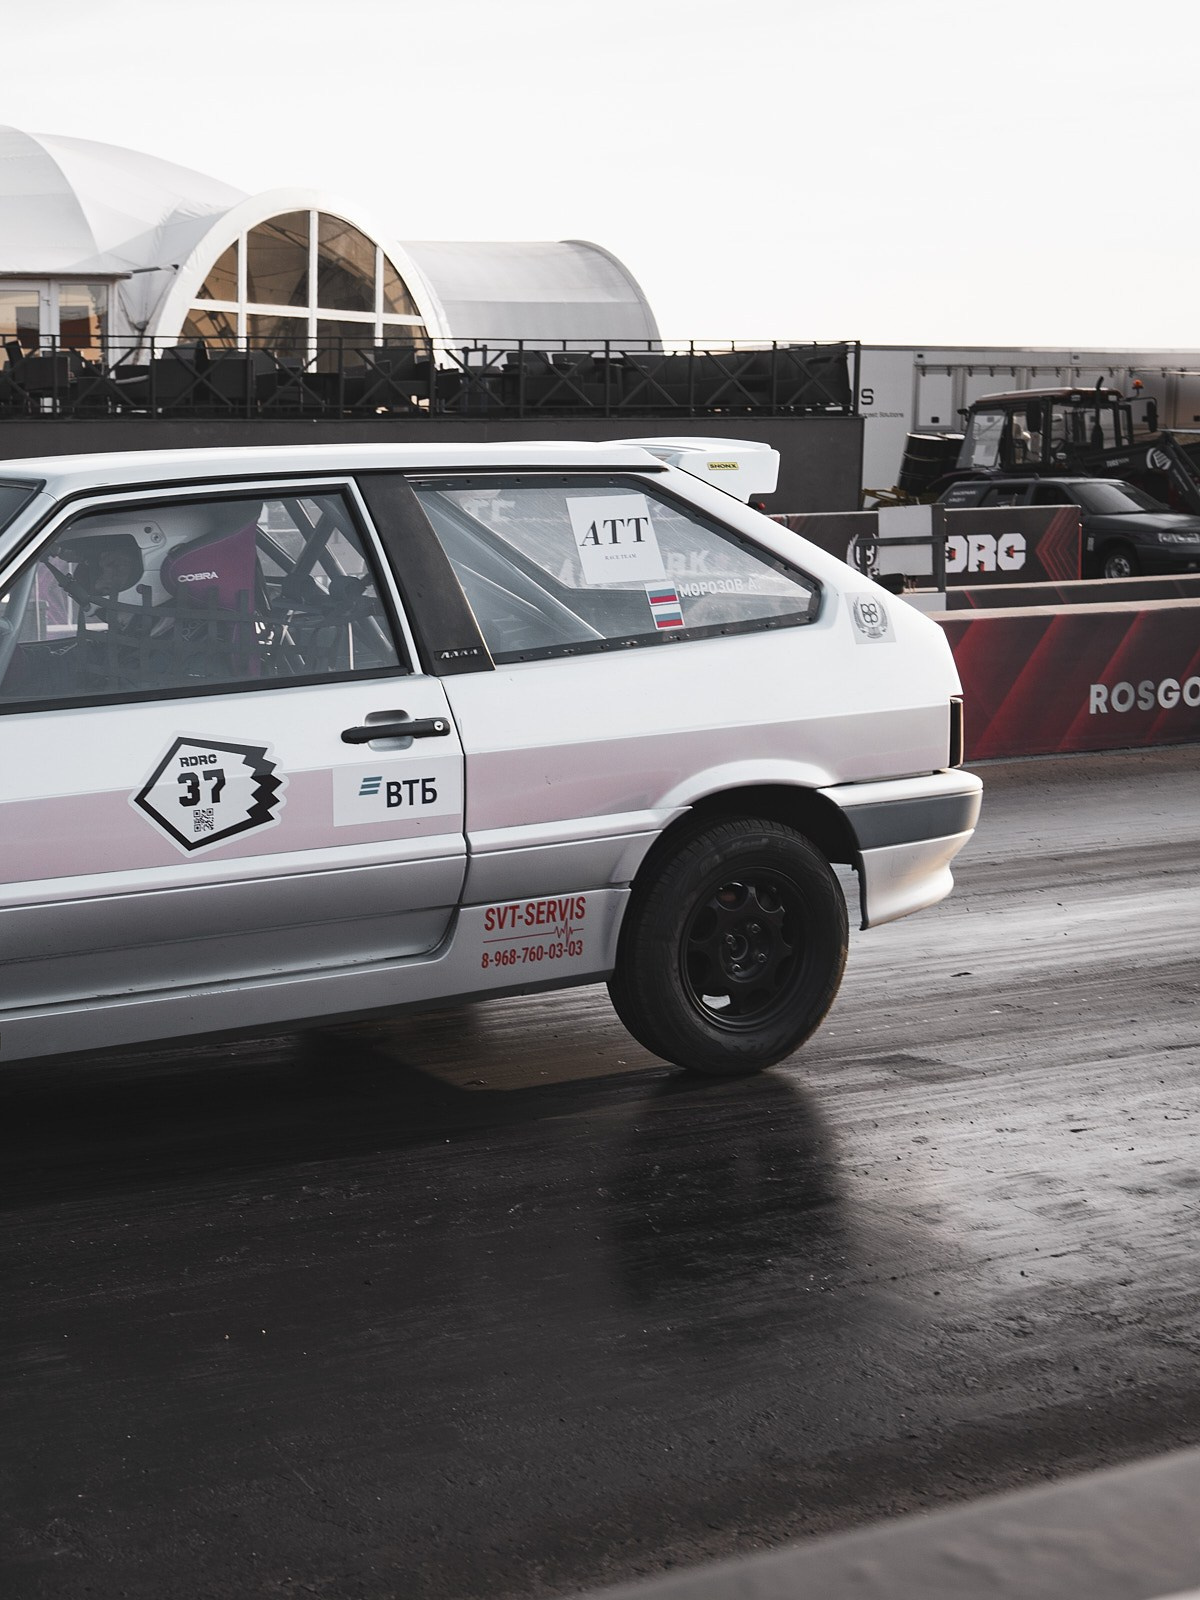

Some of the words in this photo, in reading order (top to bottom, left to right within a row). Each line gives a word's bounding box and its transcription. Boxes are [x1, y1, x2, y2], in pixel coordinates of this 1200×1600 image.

[579, 517, 649, 547] ATT
[945, 533, 1026, 574] DRC
[178, 571, 219, 582] COBRA
[678, 580, 743, 598] МОРОЗОВ
[1089, 676, 1200, 714] ROSGO
[179, 754, 218, 768] RDRC
[177, 768, 226, 807] 37
[386, 777, 438, 808] ВТБ
[484, 896, 586, 931] SVT-SERVIS
[481, 939, 583, 968] 8-968-760-03-03
